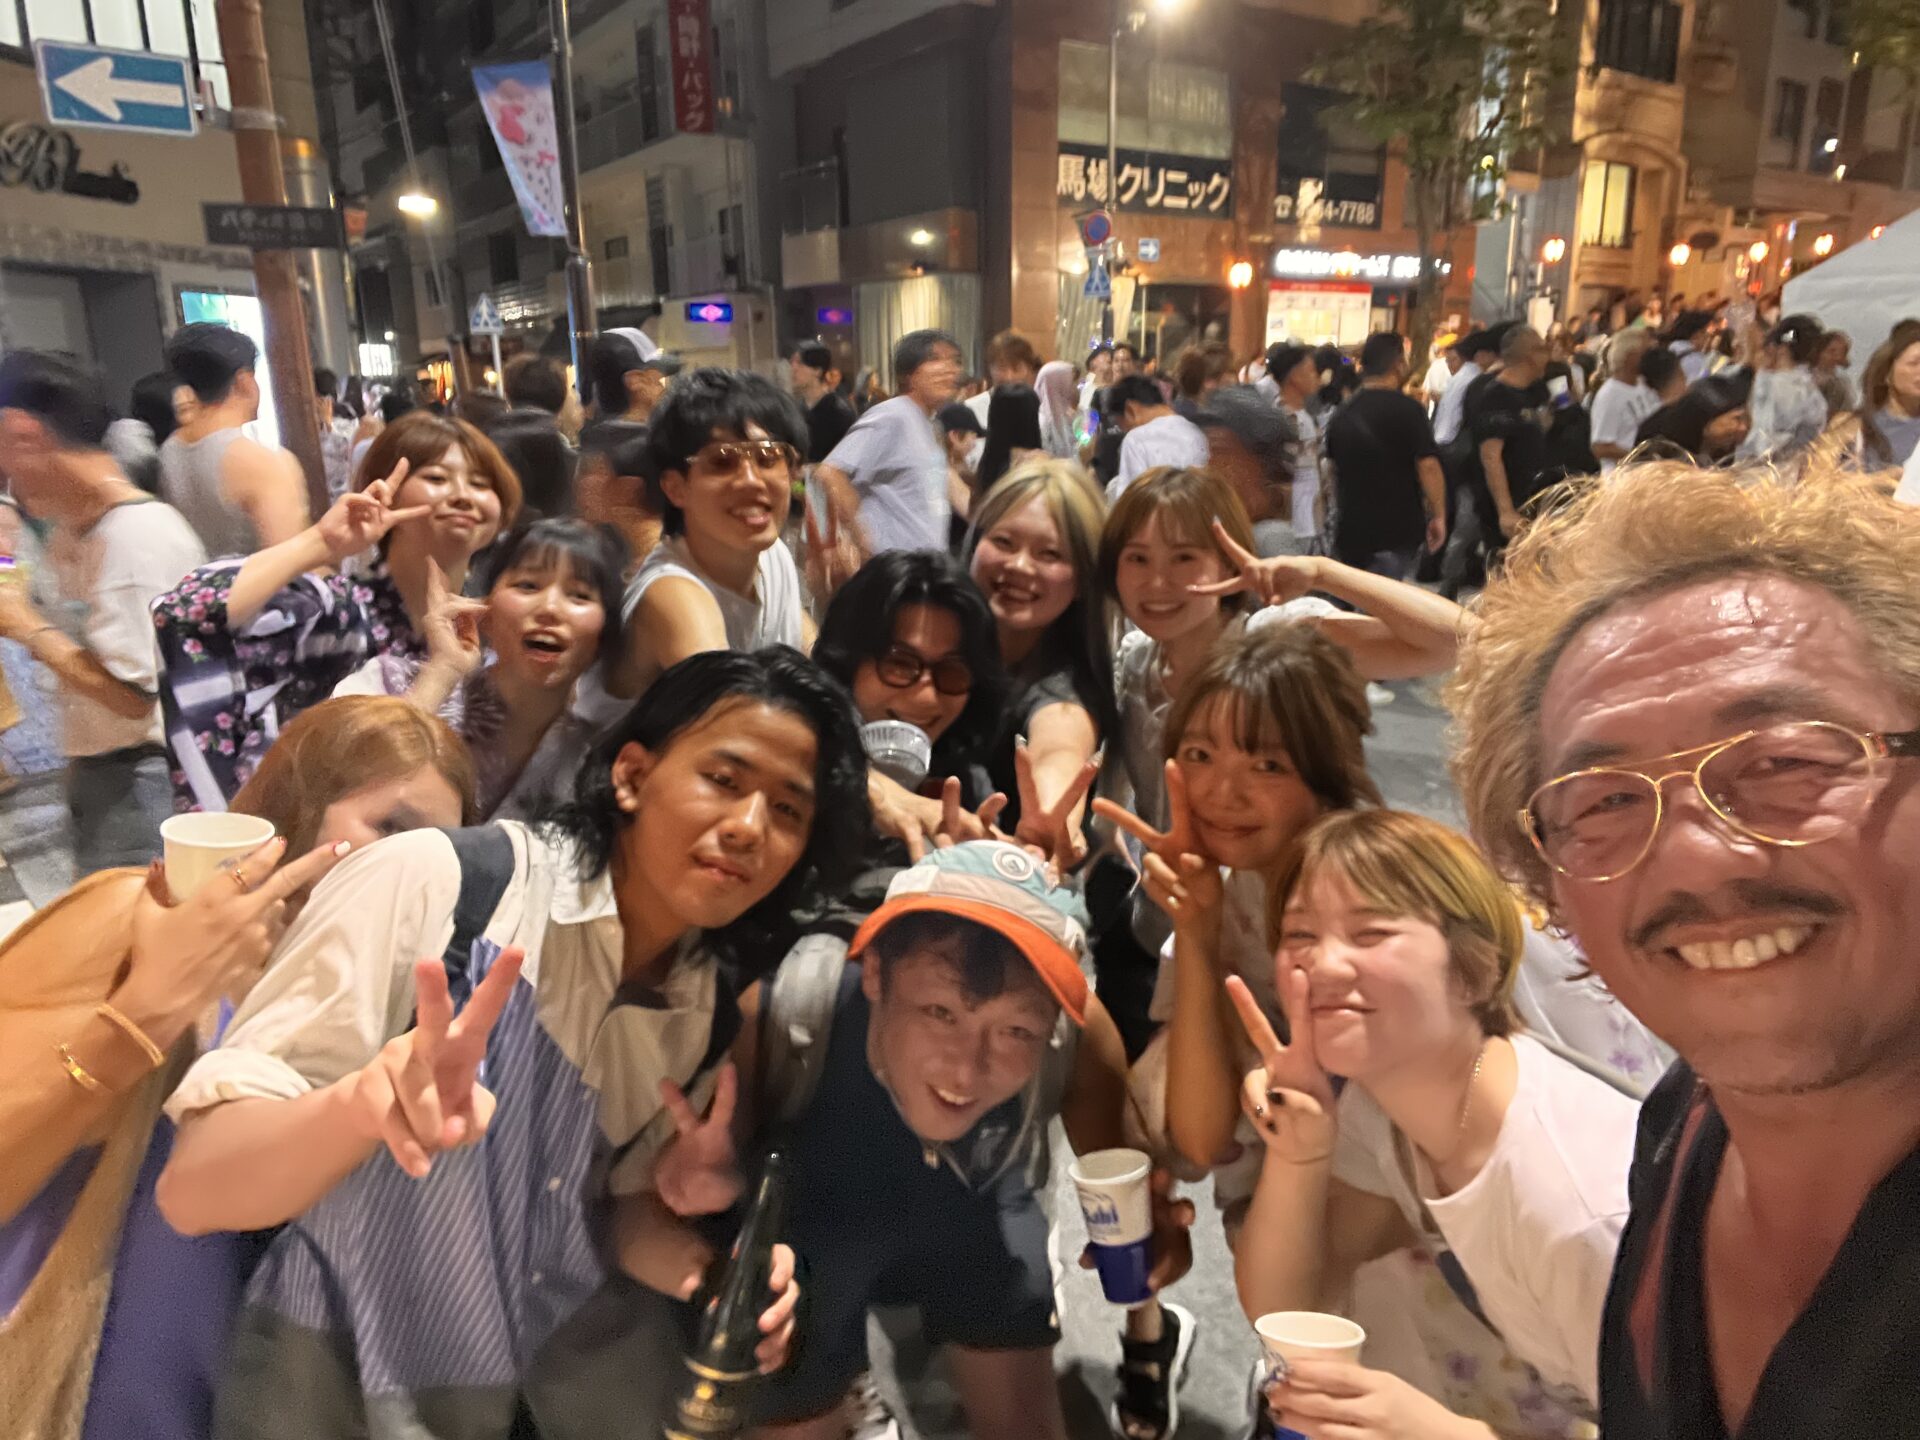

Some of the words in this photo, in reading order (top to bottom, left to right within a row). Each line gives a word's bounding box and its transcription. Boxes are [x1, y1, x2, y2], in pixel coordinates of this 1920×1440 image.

[1056, 153, 1230, 213] 馬場クリニック
